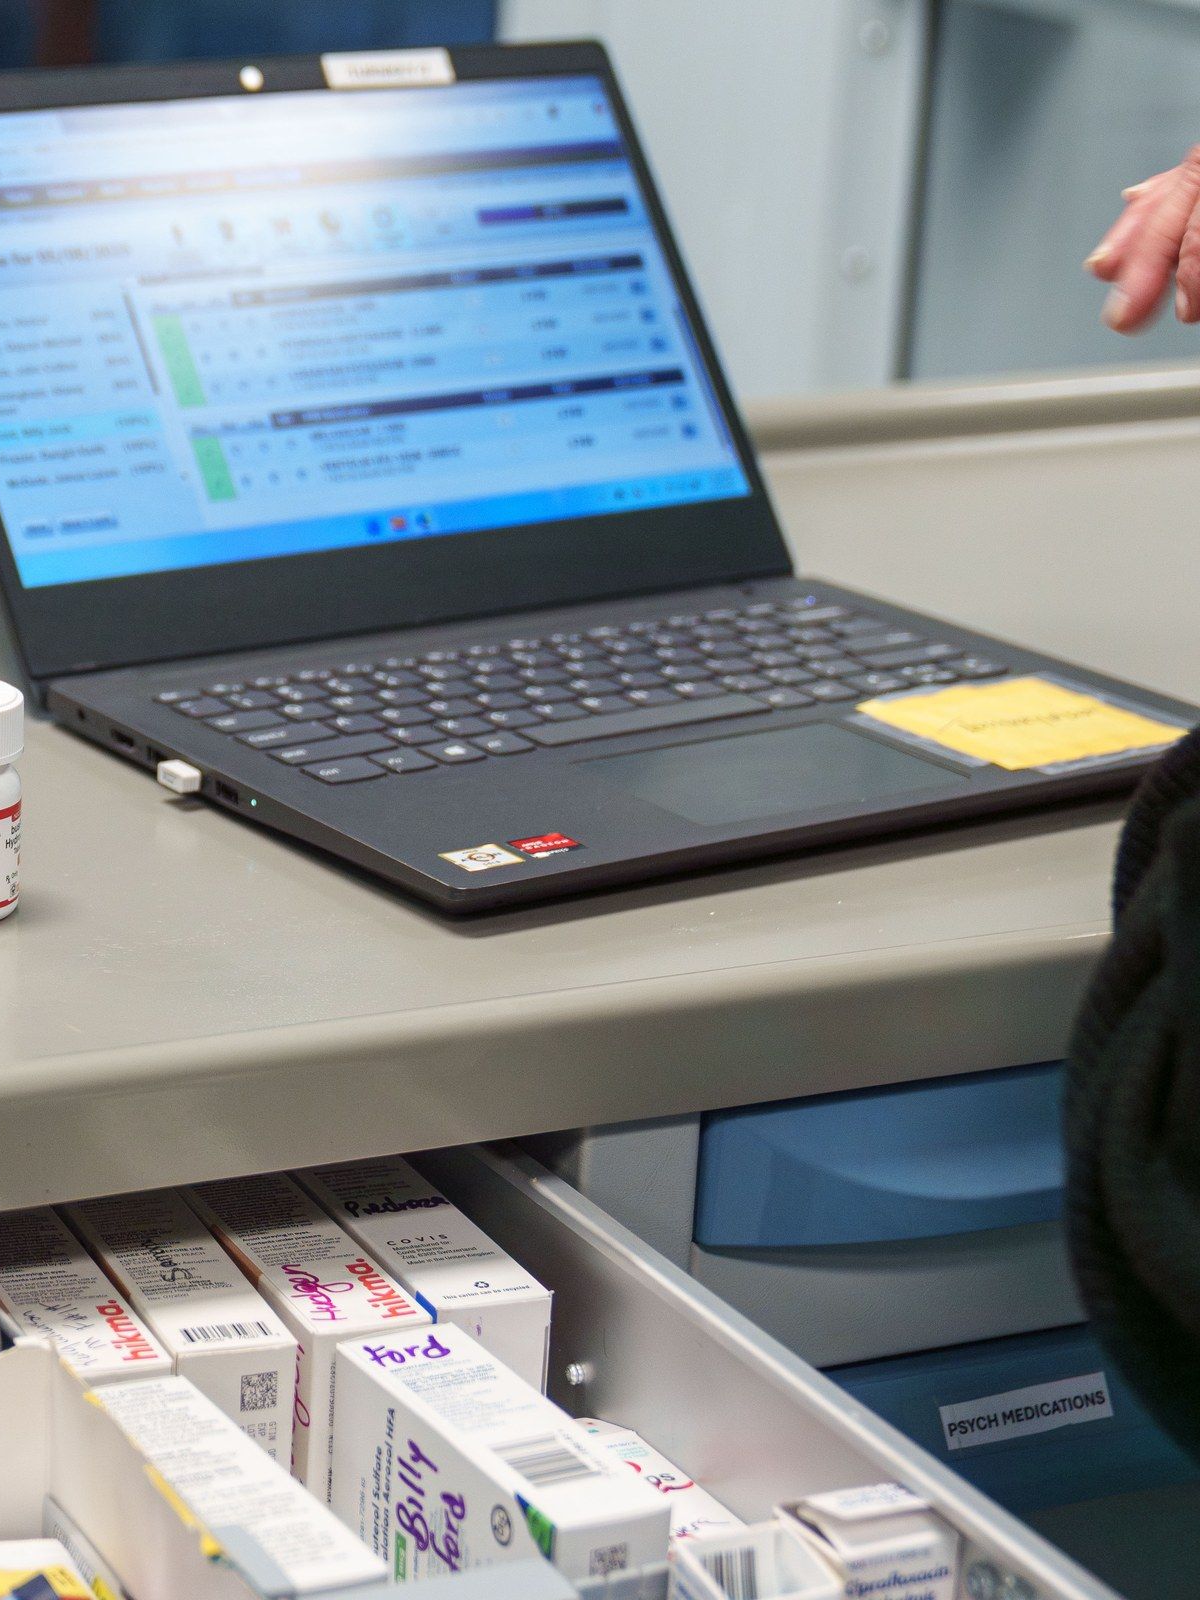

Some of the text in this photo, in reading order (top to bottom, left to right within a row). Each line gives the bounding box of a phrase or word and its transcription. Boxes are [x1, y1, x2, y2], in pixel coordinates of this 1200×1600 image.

[387, 1234, 448, 1246] COVIS
[392, 1241, 440, 1252] Manufactured
[416, 1246, 443, 1254] Pharma
[434, 1255, 445, 1263] the
[445, 1253, 467, 1261] United
[467, 1250, 496, 1259] Kingdom
[437, 1246, 478, 1256] Switzerland
[502, 1284, 532, 1293] recycled.
[362, 1335, 451, 1367] Ford
[947, 1390, 1106, 1437] PSYCH MEDICATIONS
[257, 1423, 266, 1437] EXP
[268, 1421, 277, 1441] GTIN
[372, 1445, 383, 1501] Sulfate
[382, 1407, 396, 1562] alation Aerosol HFA
